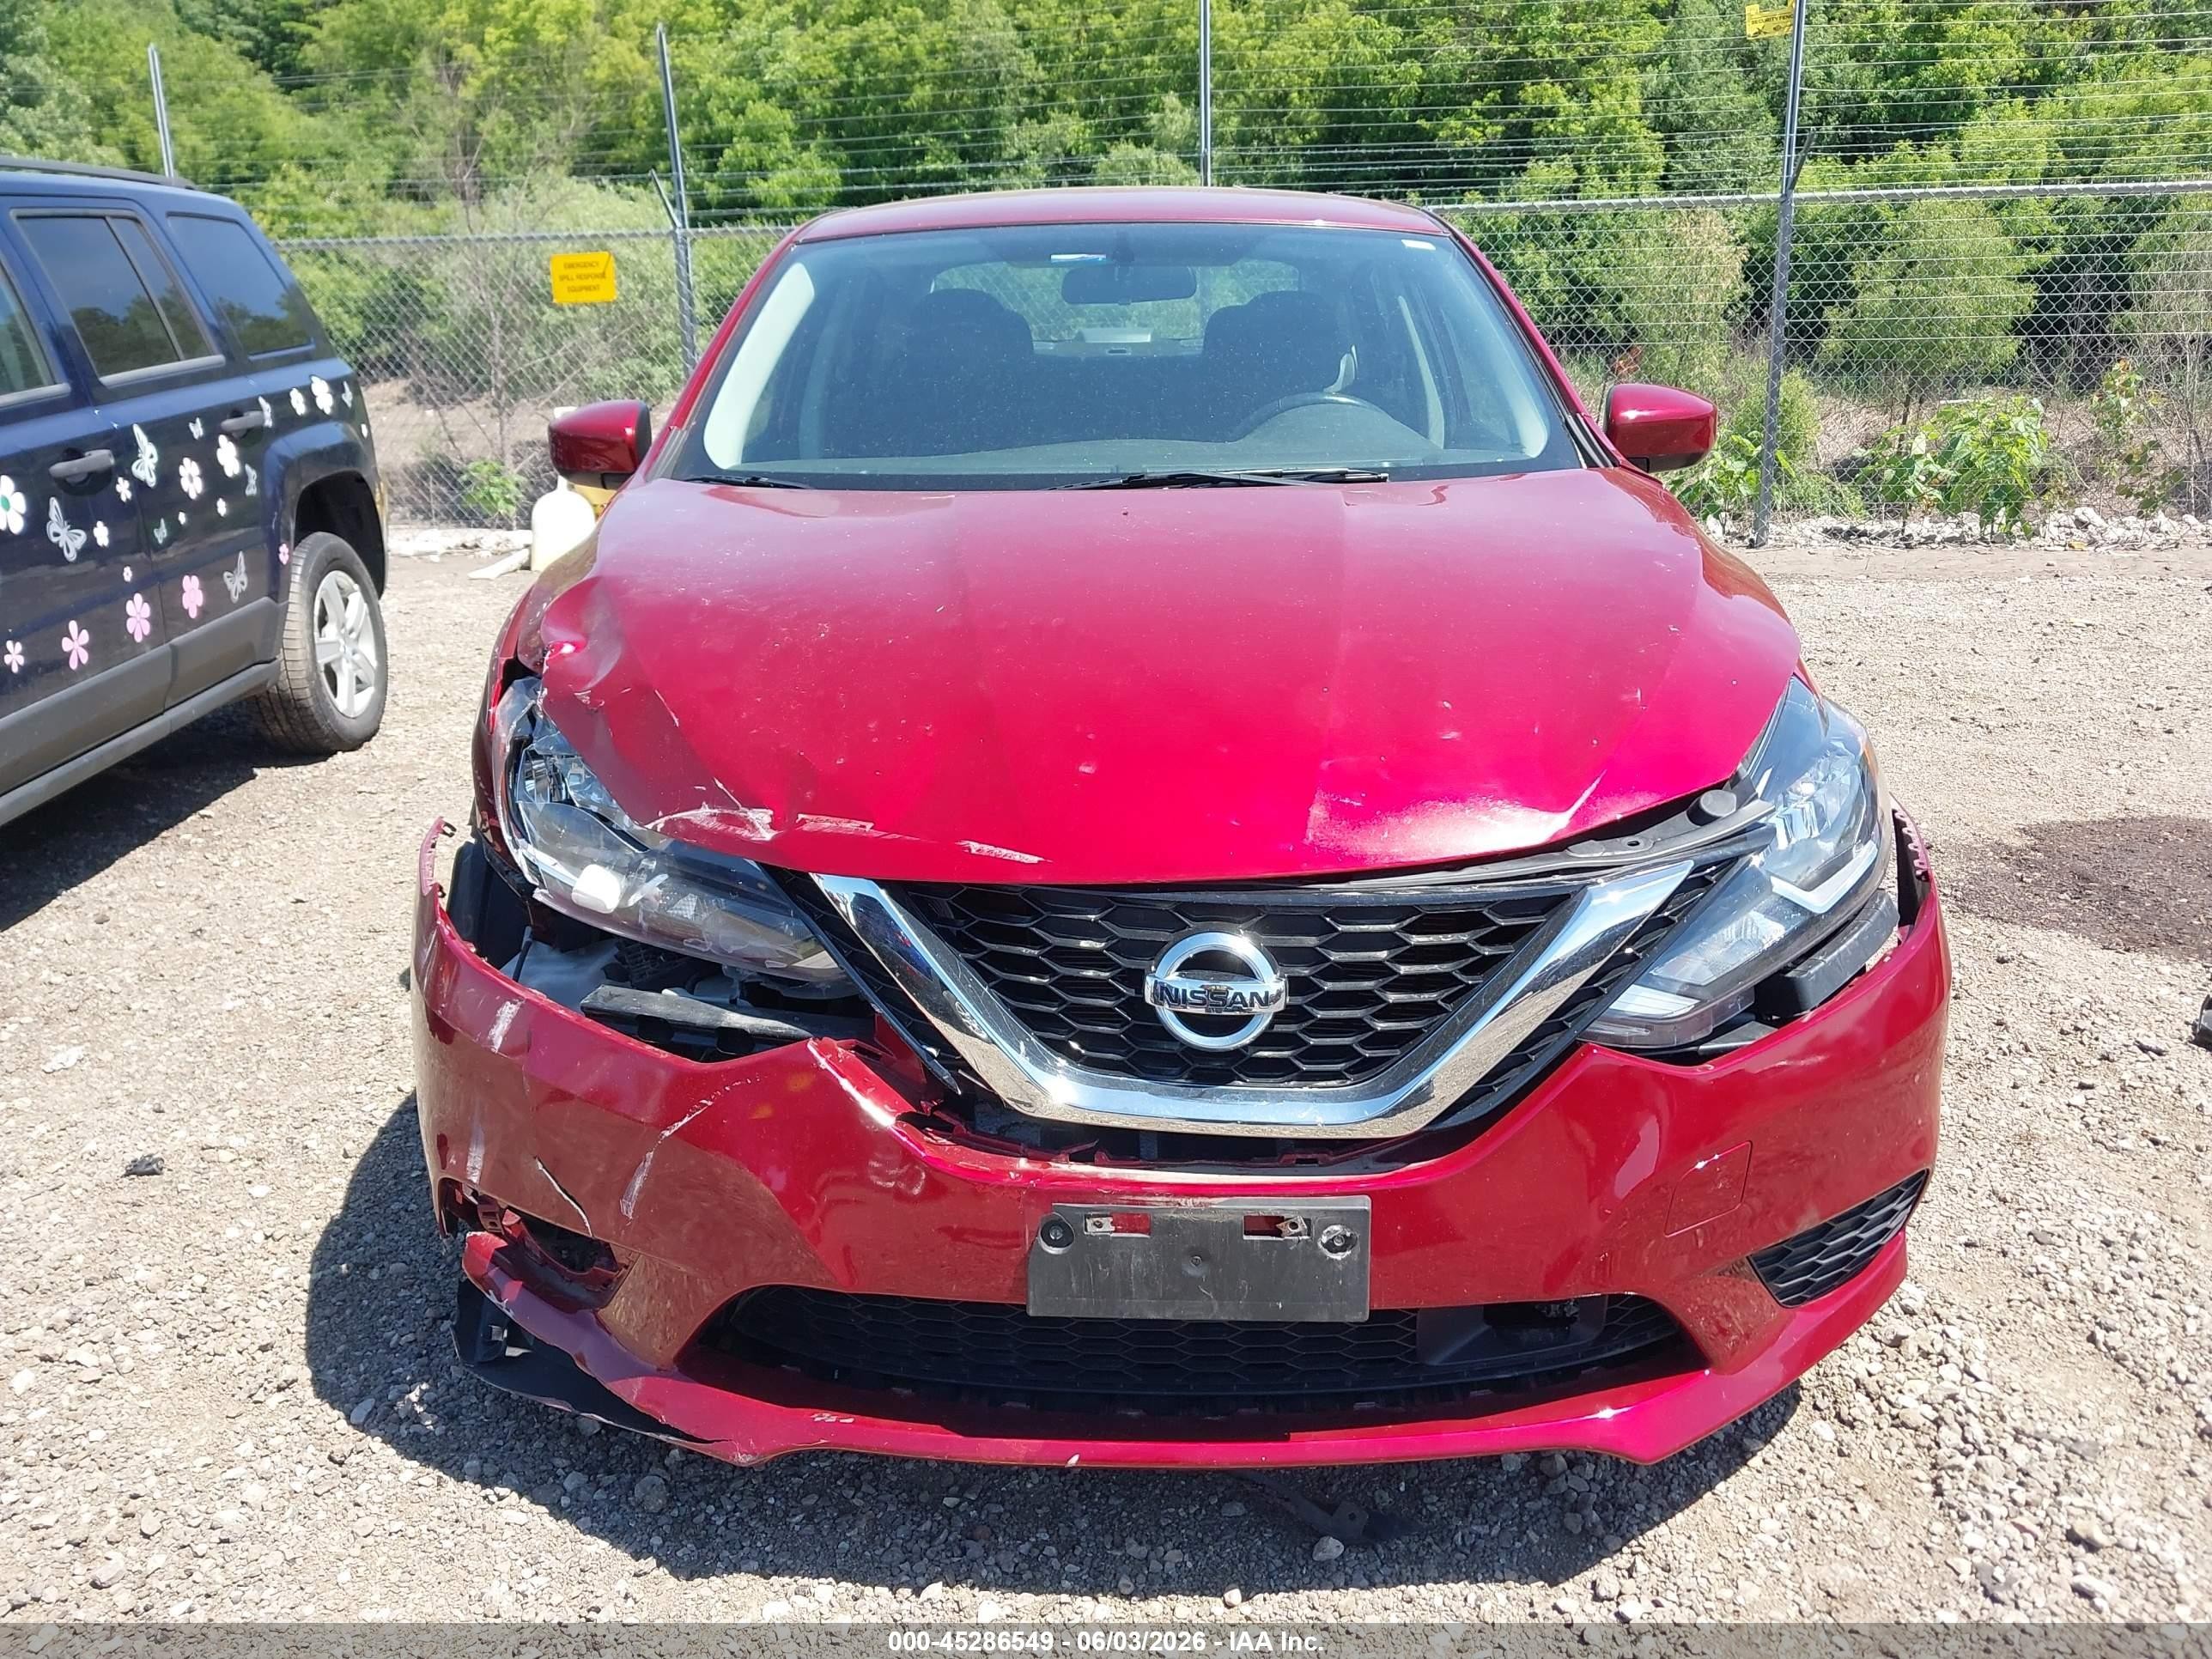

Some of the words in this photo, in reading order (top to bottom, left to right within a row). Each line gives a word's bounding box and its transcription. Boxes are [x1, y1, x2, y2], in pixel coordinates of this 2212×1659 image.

[1751, 16, 1778, 25] SECURITY
[563, 260, 599, 269] EMERGENCY
[576, 271, 605, 280] RESPONSE
[567, 284, 600, 293] EQUIPMENT
[1153, 980, 1270, 1009] NISSAN
